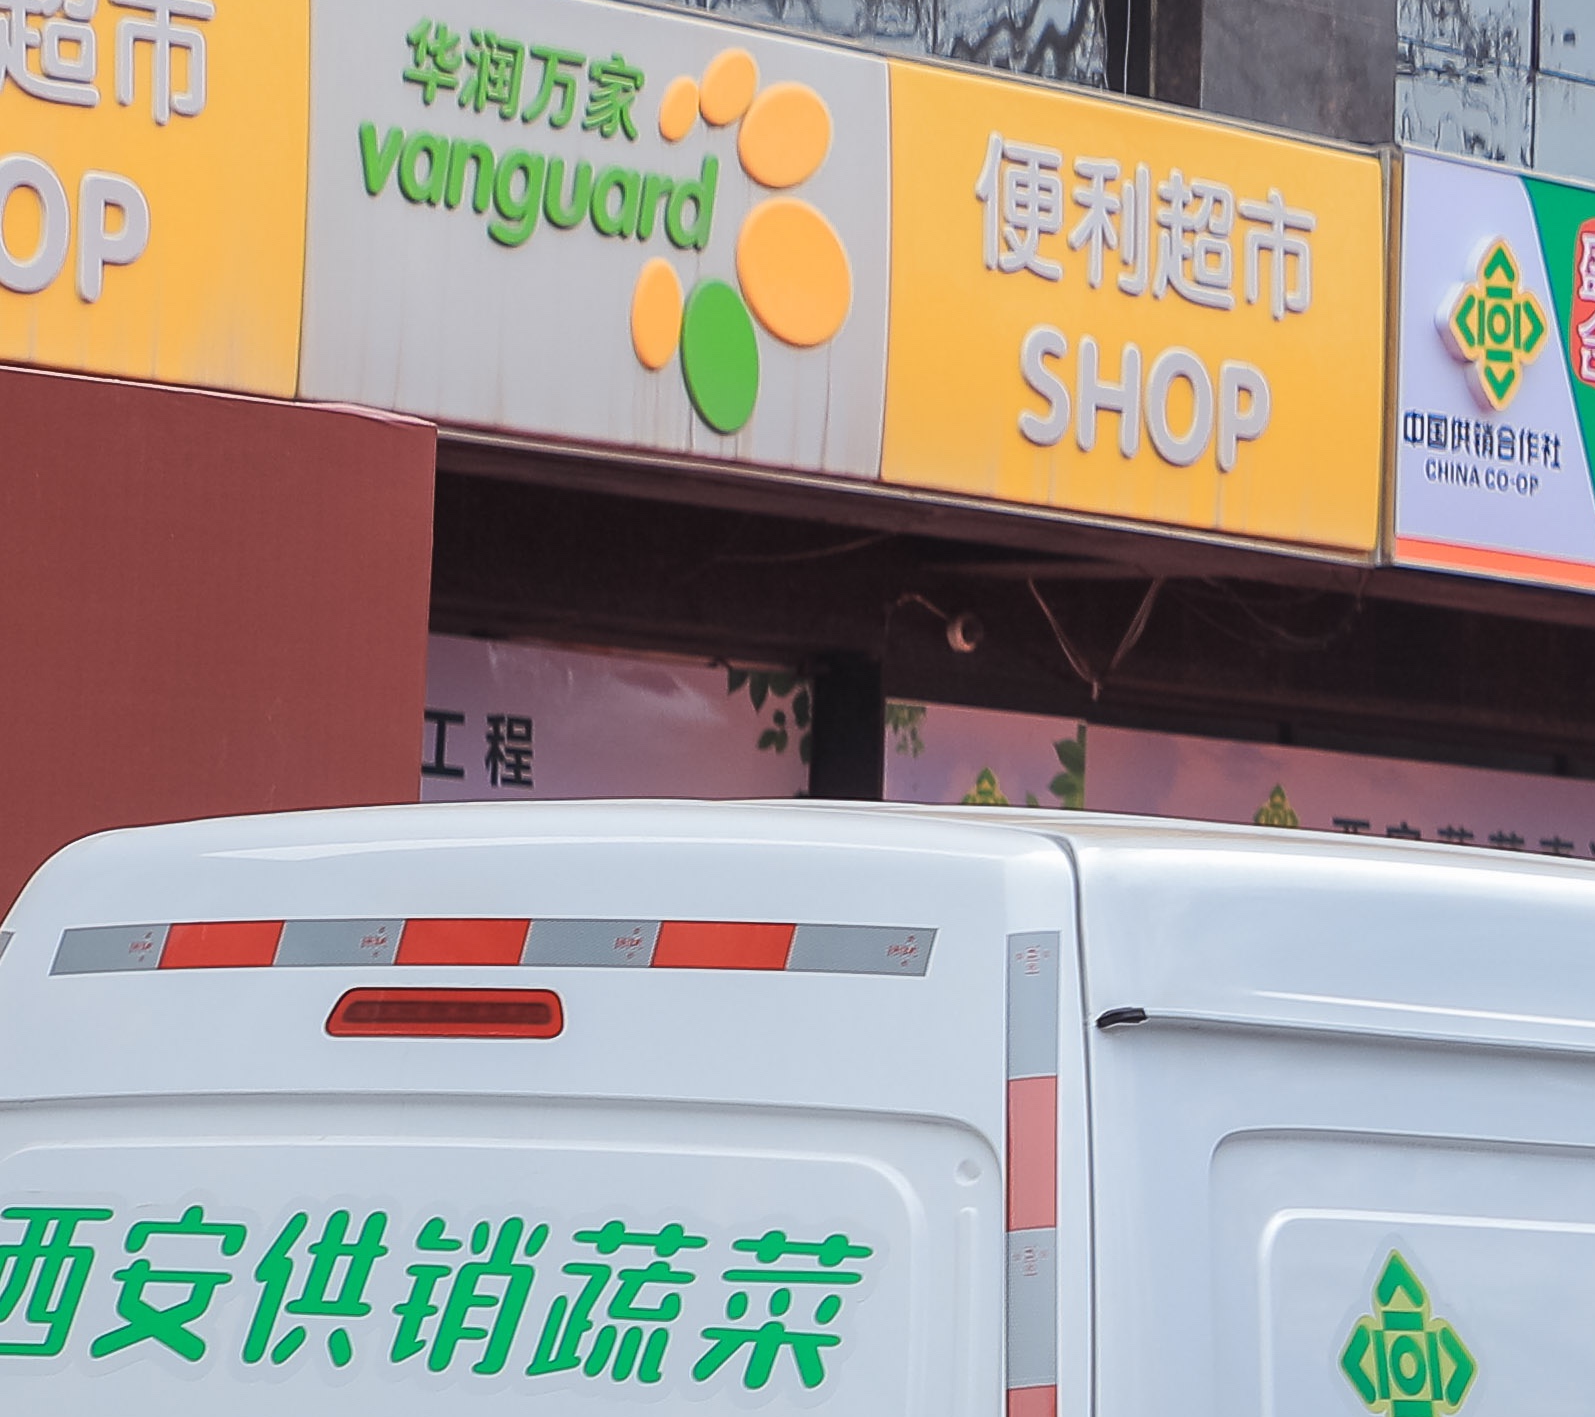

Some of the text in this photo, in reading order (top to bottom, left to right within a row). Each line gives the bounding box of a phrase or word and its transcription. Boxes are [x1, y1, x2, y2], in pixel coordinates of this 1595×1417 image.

[402, 16, 645, 142] 华润万家
[359, 120, 719, 253] vanguard
[975, 132, 1316, 322] 便利超市
[1019, 326, 1271, 473] SHOP
[1402, 409, 1562, 472] 中国供销合作社
[1424, 458, 1540, 497] CHINA CO-OP
[0, 1204, 874, 1390] 西安供销蔬菜
